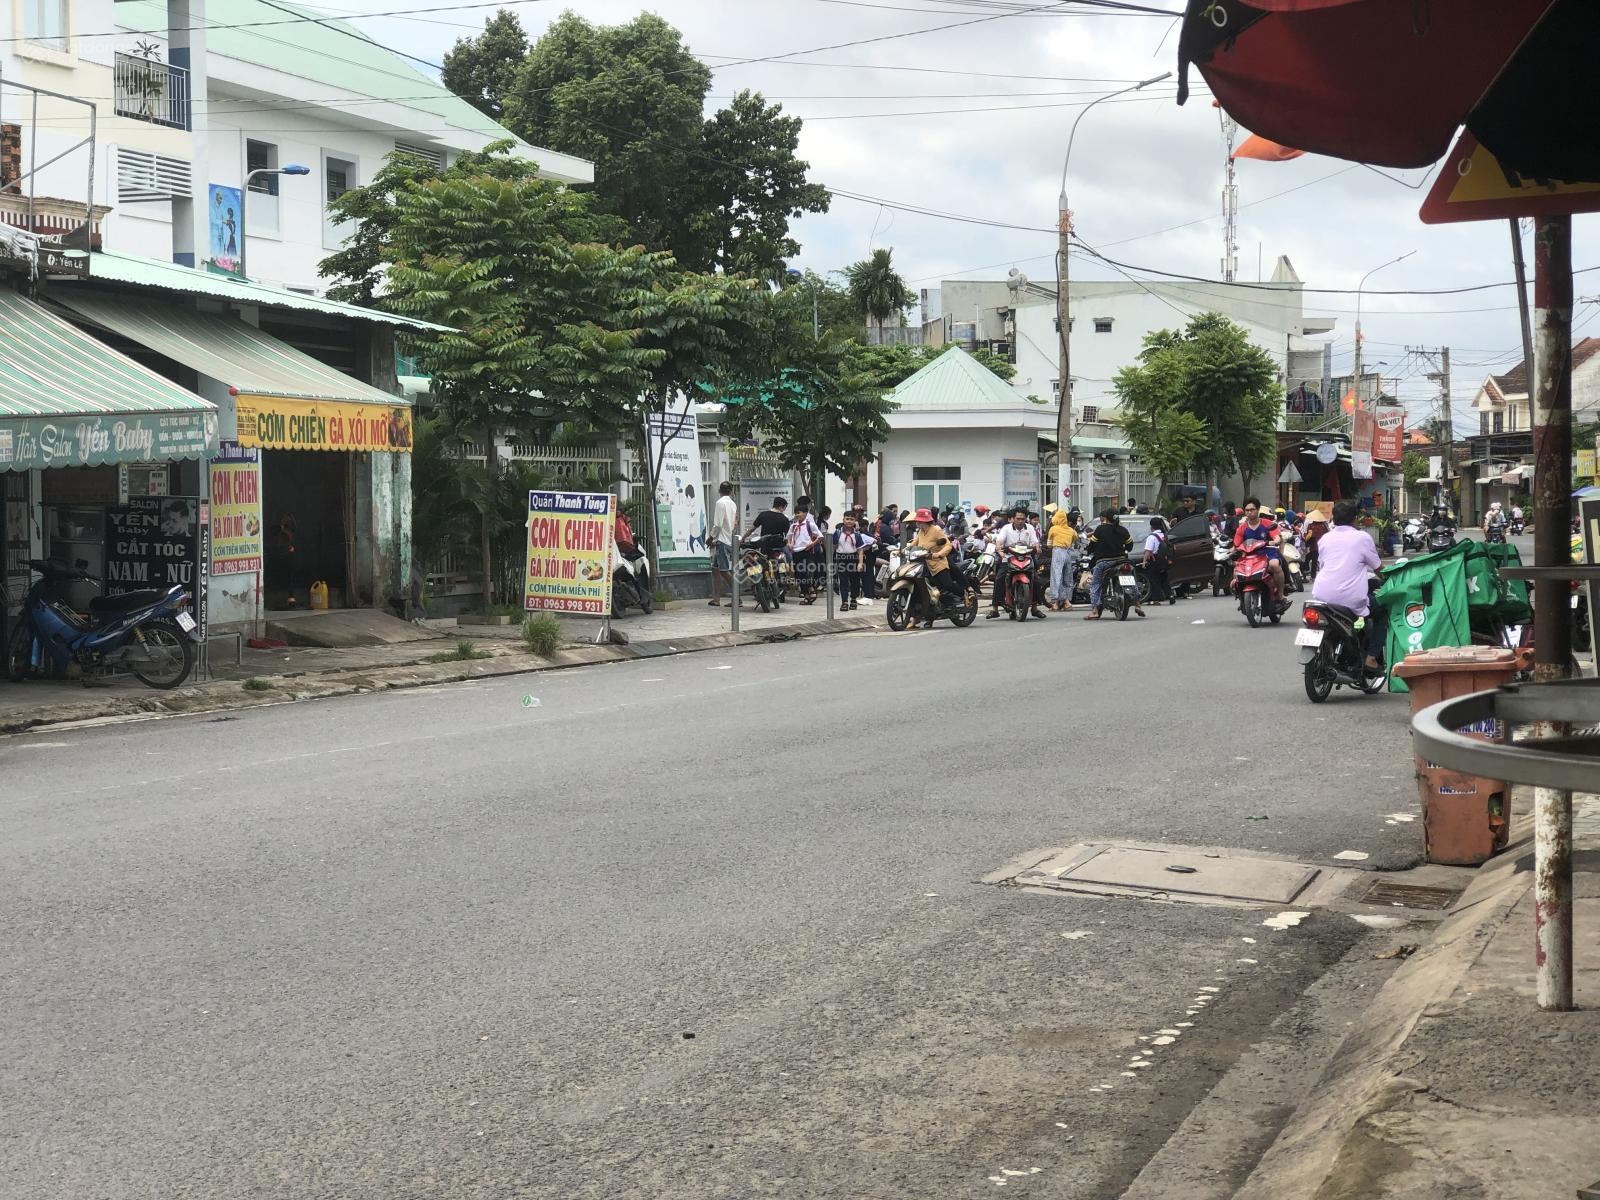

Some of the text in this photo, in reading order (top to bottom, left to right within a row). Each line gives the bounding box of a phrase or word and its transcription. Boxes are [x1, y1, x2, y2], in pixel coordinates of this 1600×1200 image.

[258, 409, 286, 443] CƠM
[289, 408, 326, 444] CHIÊN
[329, 409, 344, 445] GÀ
[348, 408, 366, 446] XỐI
[370, 413, 388, 446] MỠ
[16, 419, 37, 461] Hair
[40, 424, 72, 462] Salon
[75, 418, 110, 460] Yến
[112, 420, 154, 460] Baby
[212, 470, 232, 506] CƠM
[233, 462, 258, 505] CHIÊN
[130, 500, 159, 510] SALON
[532, 494, 553, 510] Quán
[555, 494, 582, 509] Thanh
[111, 511, 159, 526] YẾN
[213, 511, 222, 539] GÀ
[117, 526, 149, 536] Baby
[531, 513, 604, 551] CƠM CHIÊN
[116, 538, 186, 557] CẮT TÓC
[108, 561, 149, 580] NAM
[166, 560, 194, 584] NỮ
[530, 553, 578, 580] GÀ XỐI MỠ
[529, 583, 600, 597] CƠM THÊM MIỄN PHÍ
[528, 597, 601, 613] ĐT: 0963 998 931
